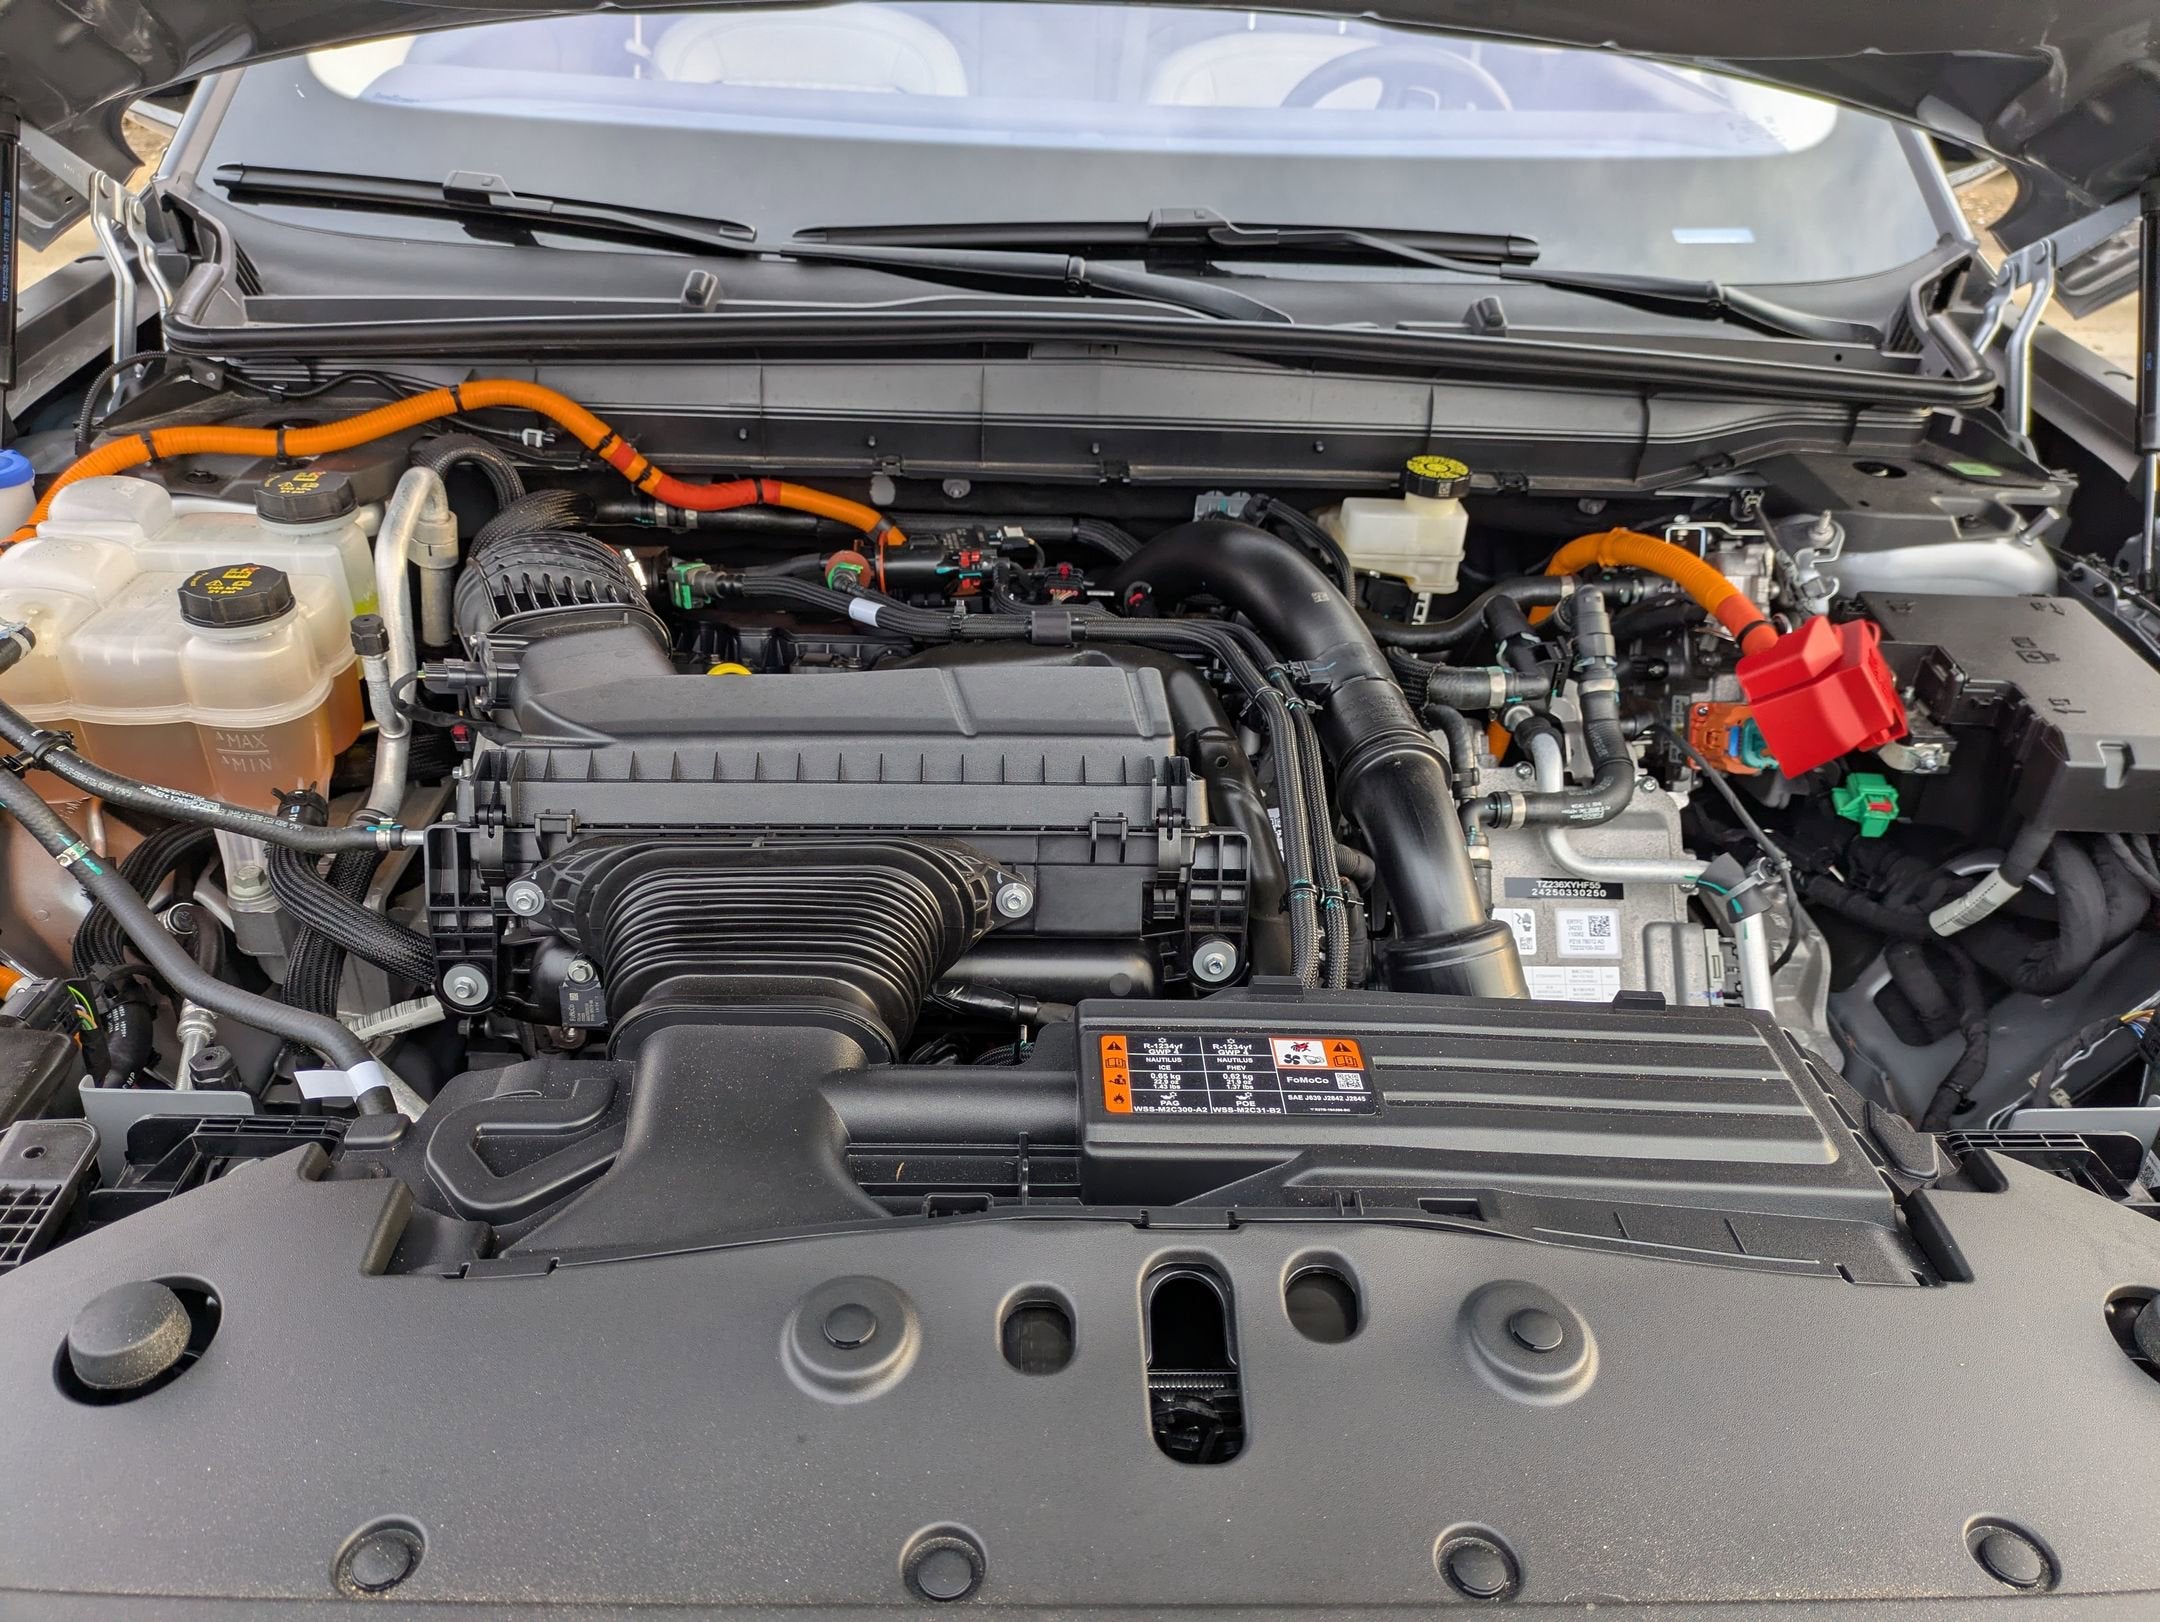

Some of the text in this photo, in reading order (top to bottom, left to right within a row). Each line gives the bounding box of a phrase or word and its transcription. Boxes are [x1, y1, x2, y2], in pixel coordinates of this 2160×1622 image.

[226, 734, 268, 749] MAX
[231, 757, 272, 773] MIN
[1531, 888, 1607, 897] 24250330250
[1170, 1073, 1181, 1081] kg
[1242, 1073, 1254, 1081] kg
[1286, 1076, 1330, 1084] FoMoCo
[1134, 1105, 1208, 1113] WSS-M2C300-A2
[1212, 1106, 1282, 1114] WSS-M2C31-B2
